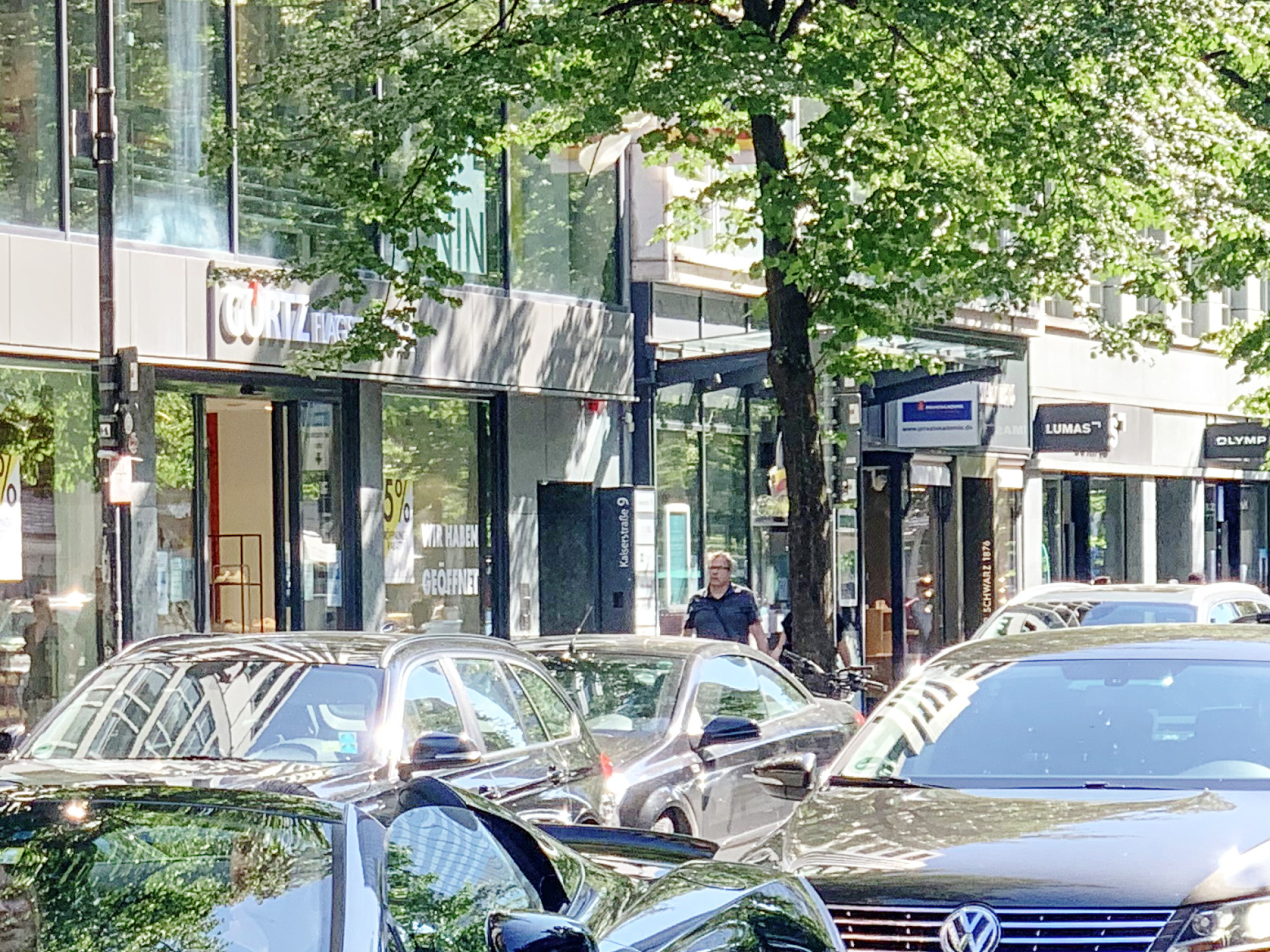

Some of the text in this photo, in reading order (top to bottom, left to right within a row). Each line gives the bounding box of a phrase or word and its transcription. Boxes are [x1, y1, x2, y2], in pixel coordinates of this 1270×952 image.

[1045, 422, 1091, 435] LUMAS
[1215, 435, 1267, 447] OLYMP
[420, 523, 444, 548] WIR
[444, 524, 479, 548] HABEN
[616, 496, 630, 568] Kaiserstraße 9
[421, 561, 479, 596] GEÖFFNET
[982, 565, 992, 613] SCHWARZ
